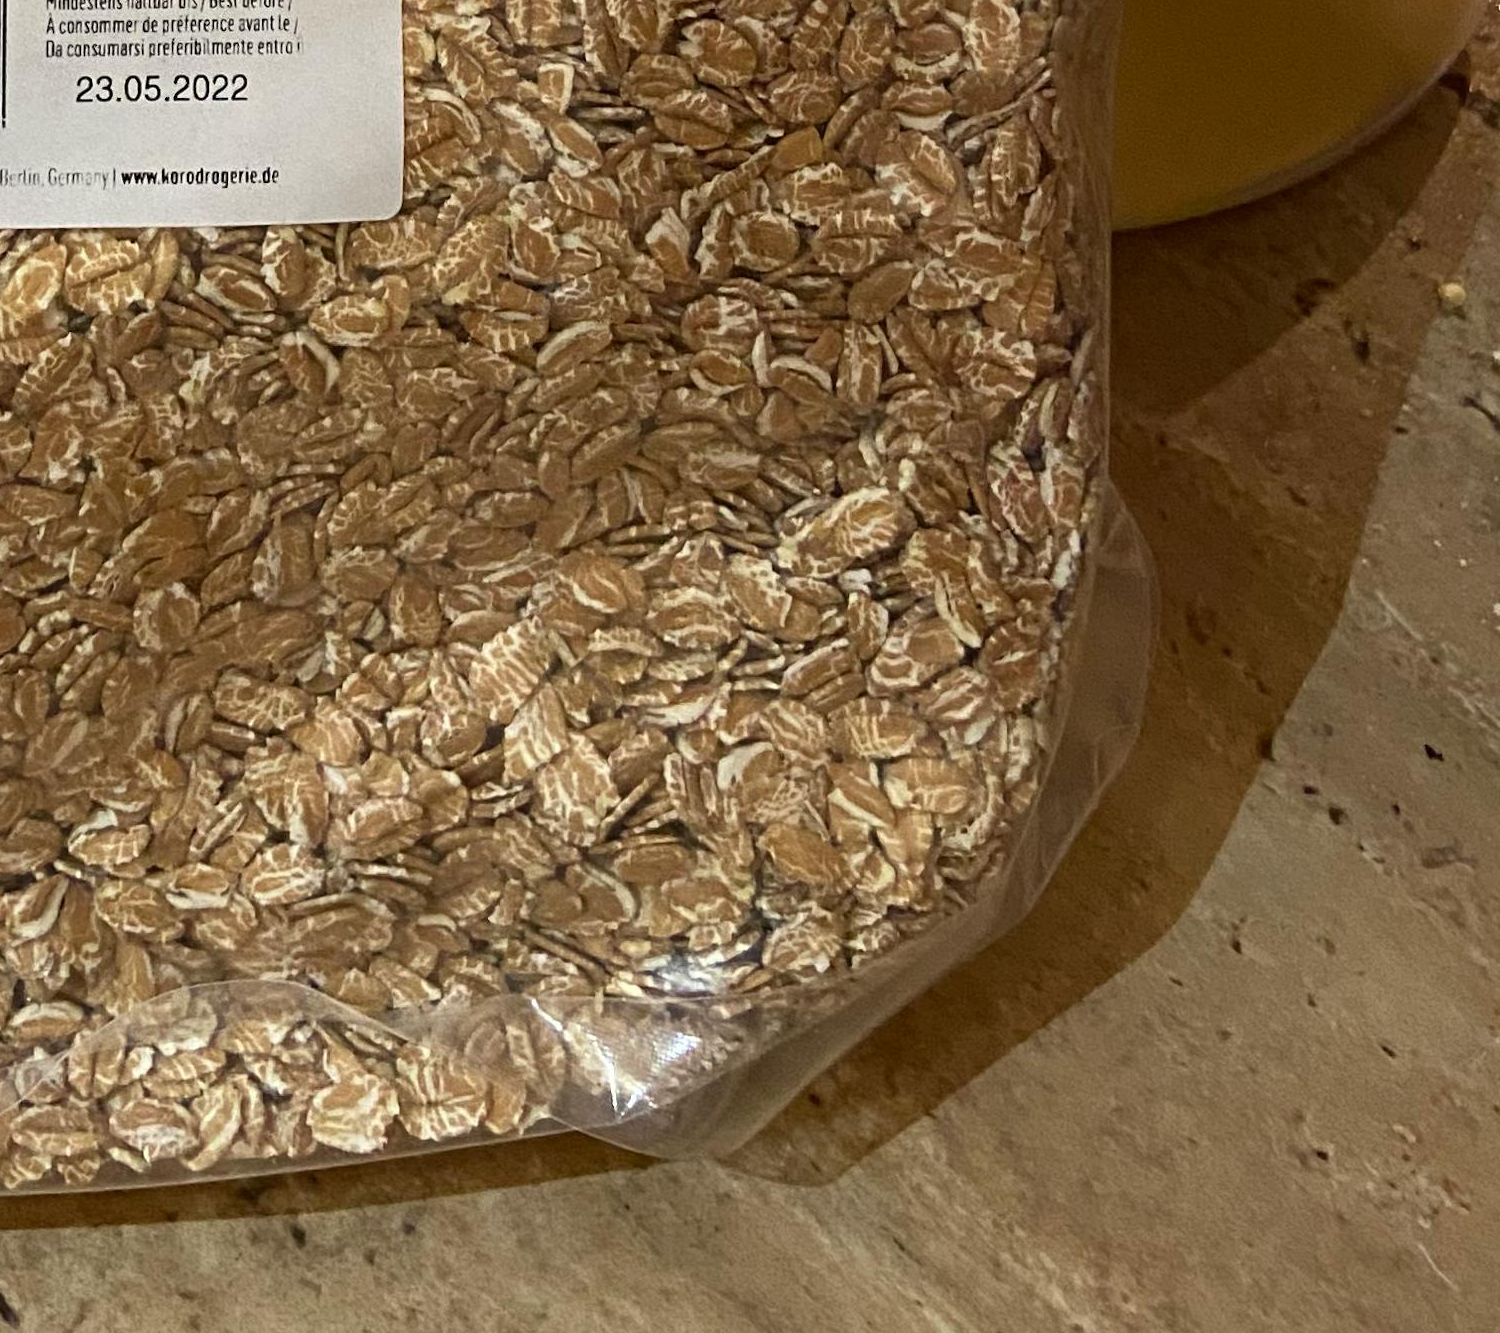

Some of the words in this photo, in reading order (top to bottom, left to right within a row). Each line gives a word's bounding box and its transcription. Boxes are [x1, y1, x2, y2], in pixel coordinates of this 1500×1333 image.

[142, 17, 158, 33] de
[76, 74, 248, 102] 23.05.2022
[121, 167, 279, 188] www.korodrogerie.de
